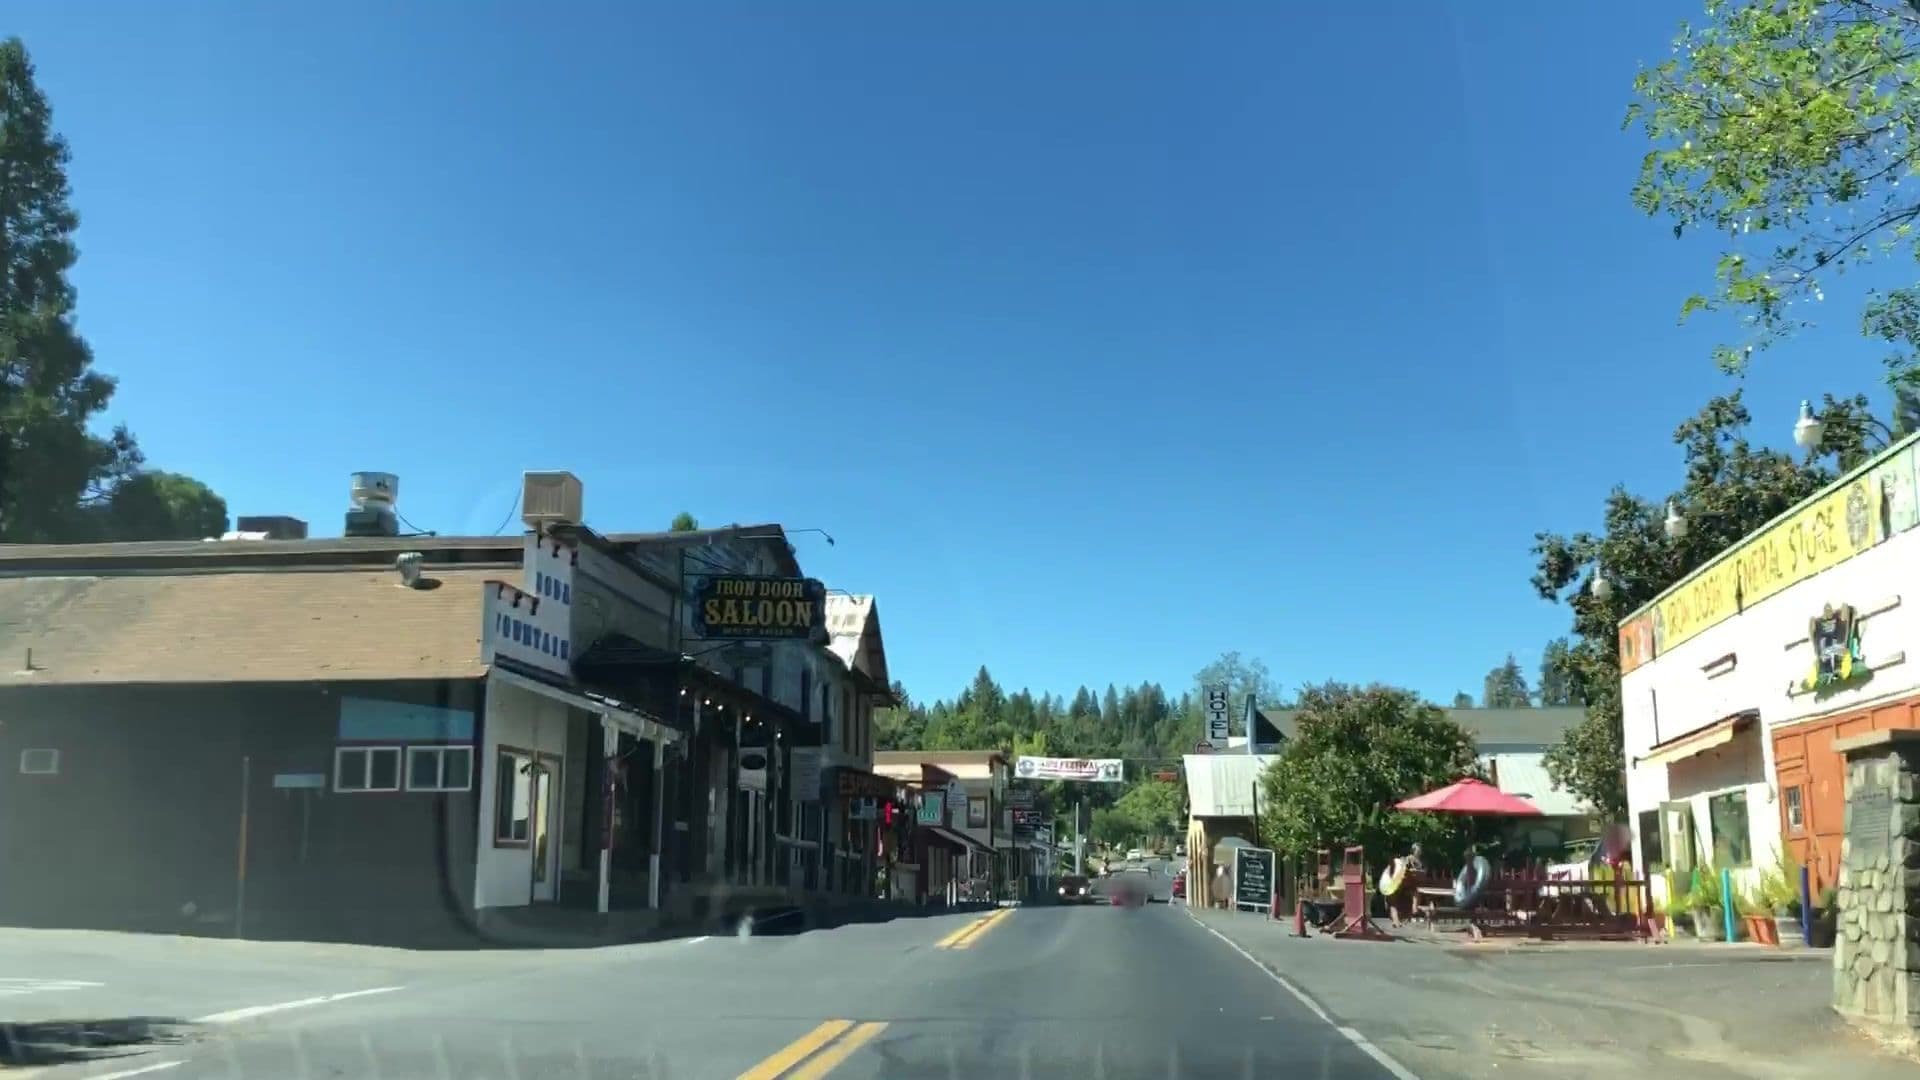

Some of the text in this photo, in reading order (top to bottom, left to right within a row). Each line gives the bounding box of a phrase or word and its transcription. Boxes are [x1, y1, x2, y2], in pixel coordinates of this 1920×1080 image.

[1788, 506, 1838, 573] STORE
[716, 580, 803, 598] IRON DOOR
[704, 599, 814, 627] SALOON
[1210, 692, 1227, 740] HOTEL
